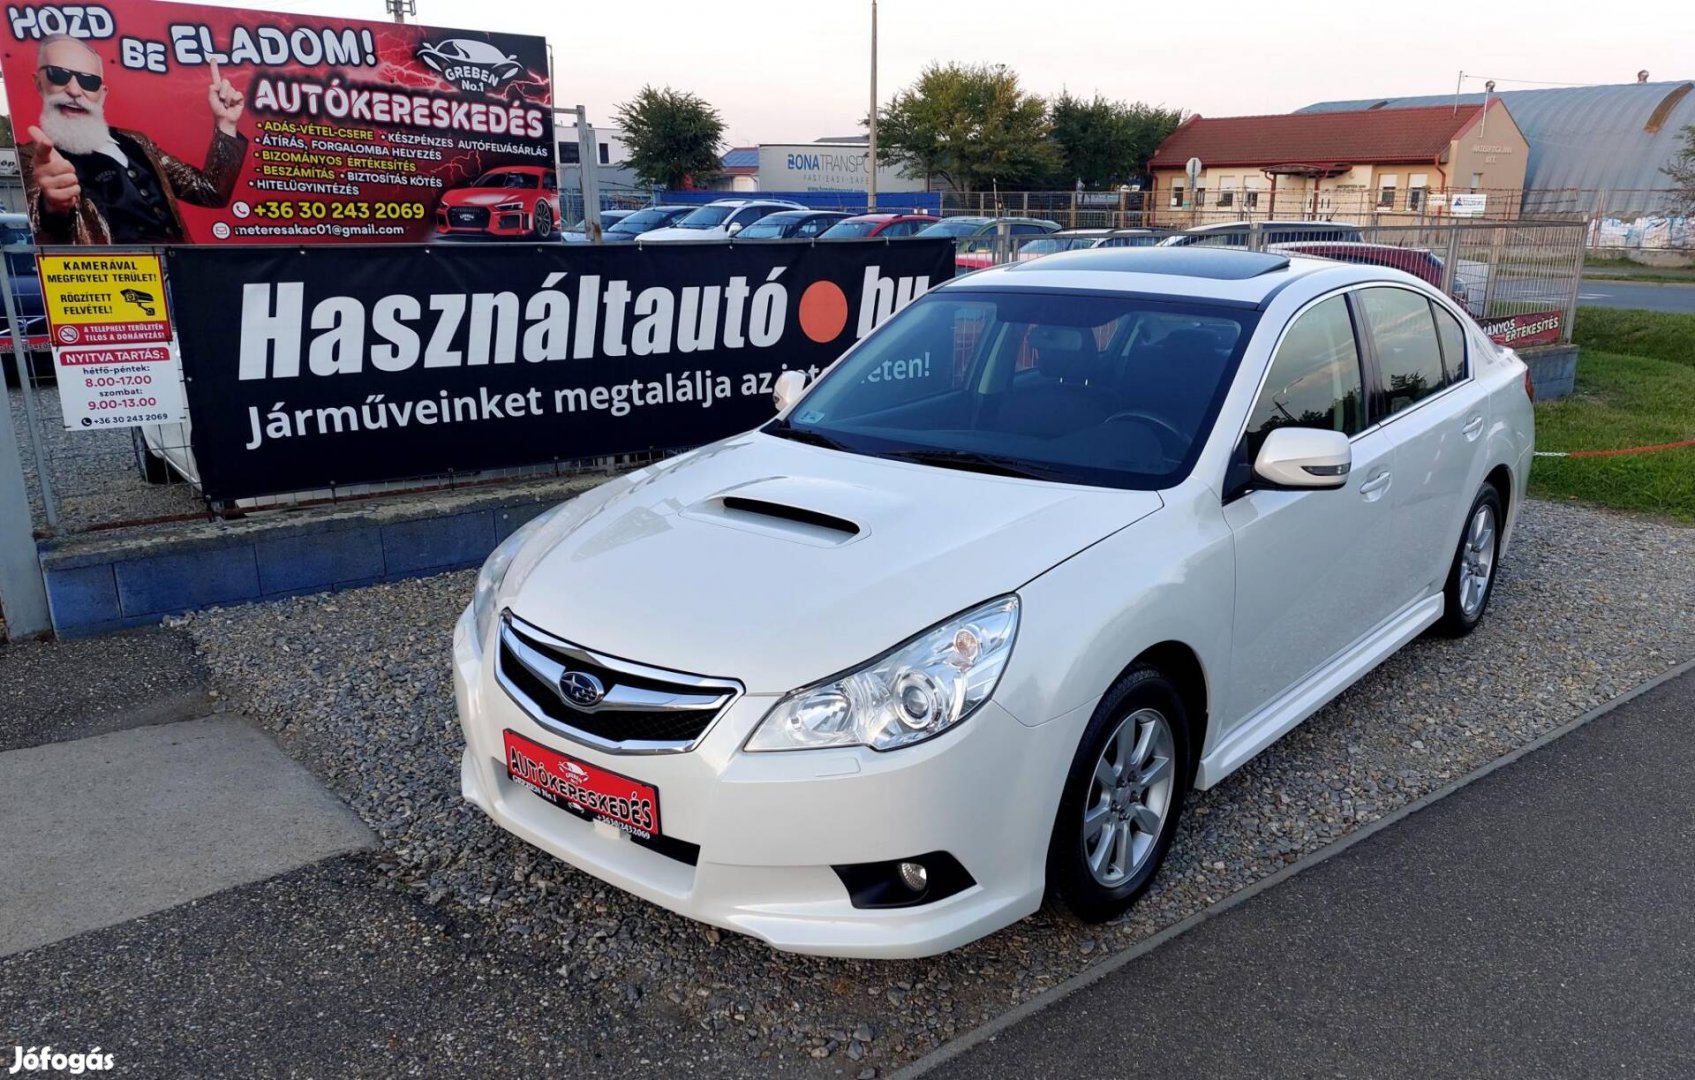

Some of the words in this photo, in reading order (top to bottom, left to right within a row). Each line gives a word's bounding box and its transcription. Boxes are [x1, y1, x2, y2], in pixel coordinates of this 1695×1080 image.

[8, 6, 116, 40] HOZD
[170, 24, 378, 66] ELADOM!
[121, 38, 168, 73] BE
[445, 65, 499, 87] GREBEN
[461, 79, 484, 92] No.1
[254, 78, 544, 138] AUTÓKERESKEDÉS
[264, 121, 374, 140] ADÁS-VÉTEL-CSERE
[262, 134, 309, 150] ÁTÍRÁS,
[311, 140, 390, 156] FORGALOMBA
[392, 147, 442, 161] HELYEZÉS
[387, 133, 454, 148] KÉSZPÉNZES
[457, 139, 548, 157] AUTÓFELVÁSÁRLÁS
[262, 150, 342, 166] BIZOMÁNYOS
[347, 156, 416, 172] ÉRTÉKESÍTÉS
[263, 164, 335, 179] BESZÁMÍTÁS
[347, 172, 407, 185] BIZTOSÍTÁS
[410, 175, 443, 188] KÖTÉS
[257, 179, 359, 195] HITELÜGYINTÉZÉS
[254, 201, 294, 219] +36
[299, 202, 326, 219] 30
[331, 202, 370, 219] 243
[374, 202, 425, 219] 2069
[63, 259, 138, 271] KAMERÁVAL
[47, 273, 108, 283] MEGFIGYELT
[113, 271, 157, 282] TERÜLET!
[60, 292, 112, 303] RÖGZÍTETT
[63, 304, 113, 315] FELVÉTEL!
[238, 266, 788, 381] Használtautó
[1505, 315, 1559, 343] ÉRTÉKESÍTÉS
[65, 352, 114, 364] NYITVA
[117, 349, 165, 362] TARTÁS:
[82, 364, 151, 375] hétfő-péntek:
[85, 375, 152, 388] 8.00-17.00
[99, 388, 143, 397] szombat:
[88, 397, 157, 411] 9.00-13.00
[246, 386, 544, 451] Járműveinket
[554, 370, 732, 417] megtalálja
[741, 371, 773, 396] az
[113, 416, 125, 424] 30
[145, 413, 168, 421] 2069
[510, 745, 654, 831] AUTÓKERESKEDÉS
